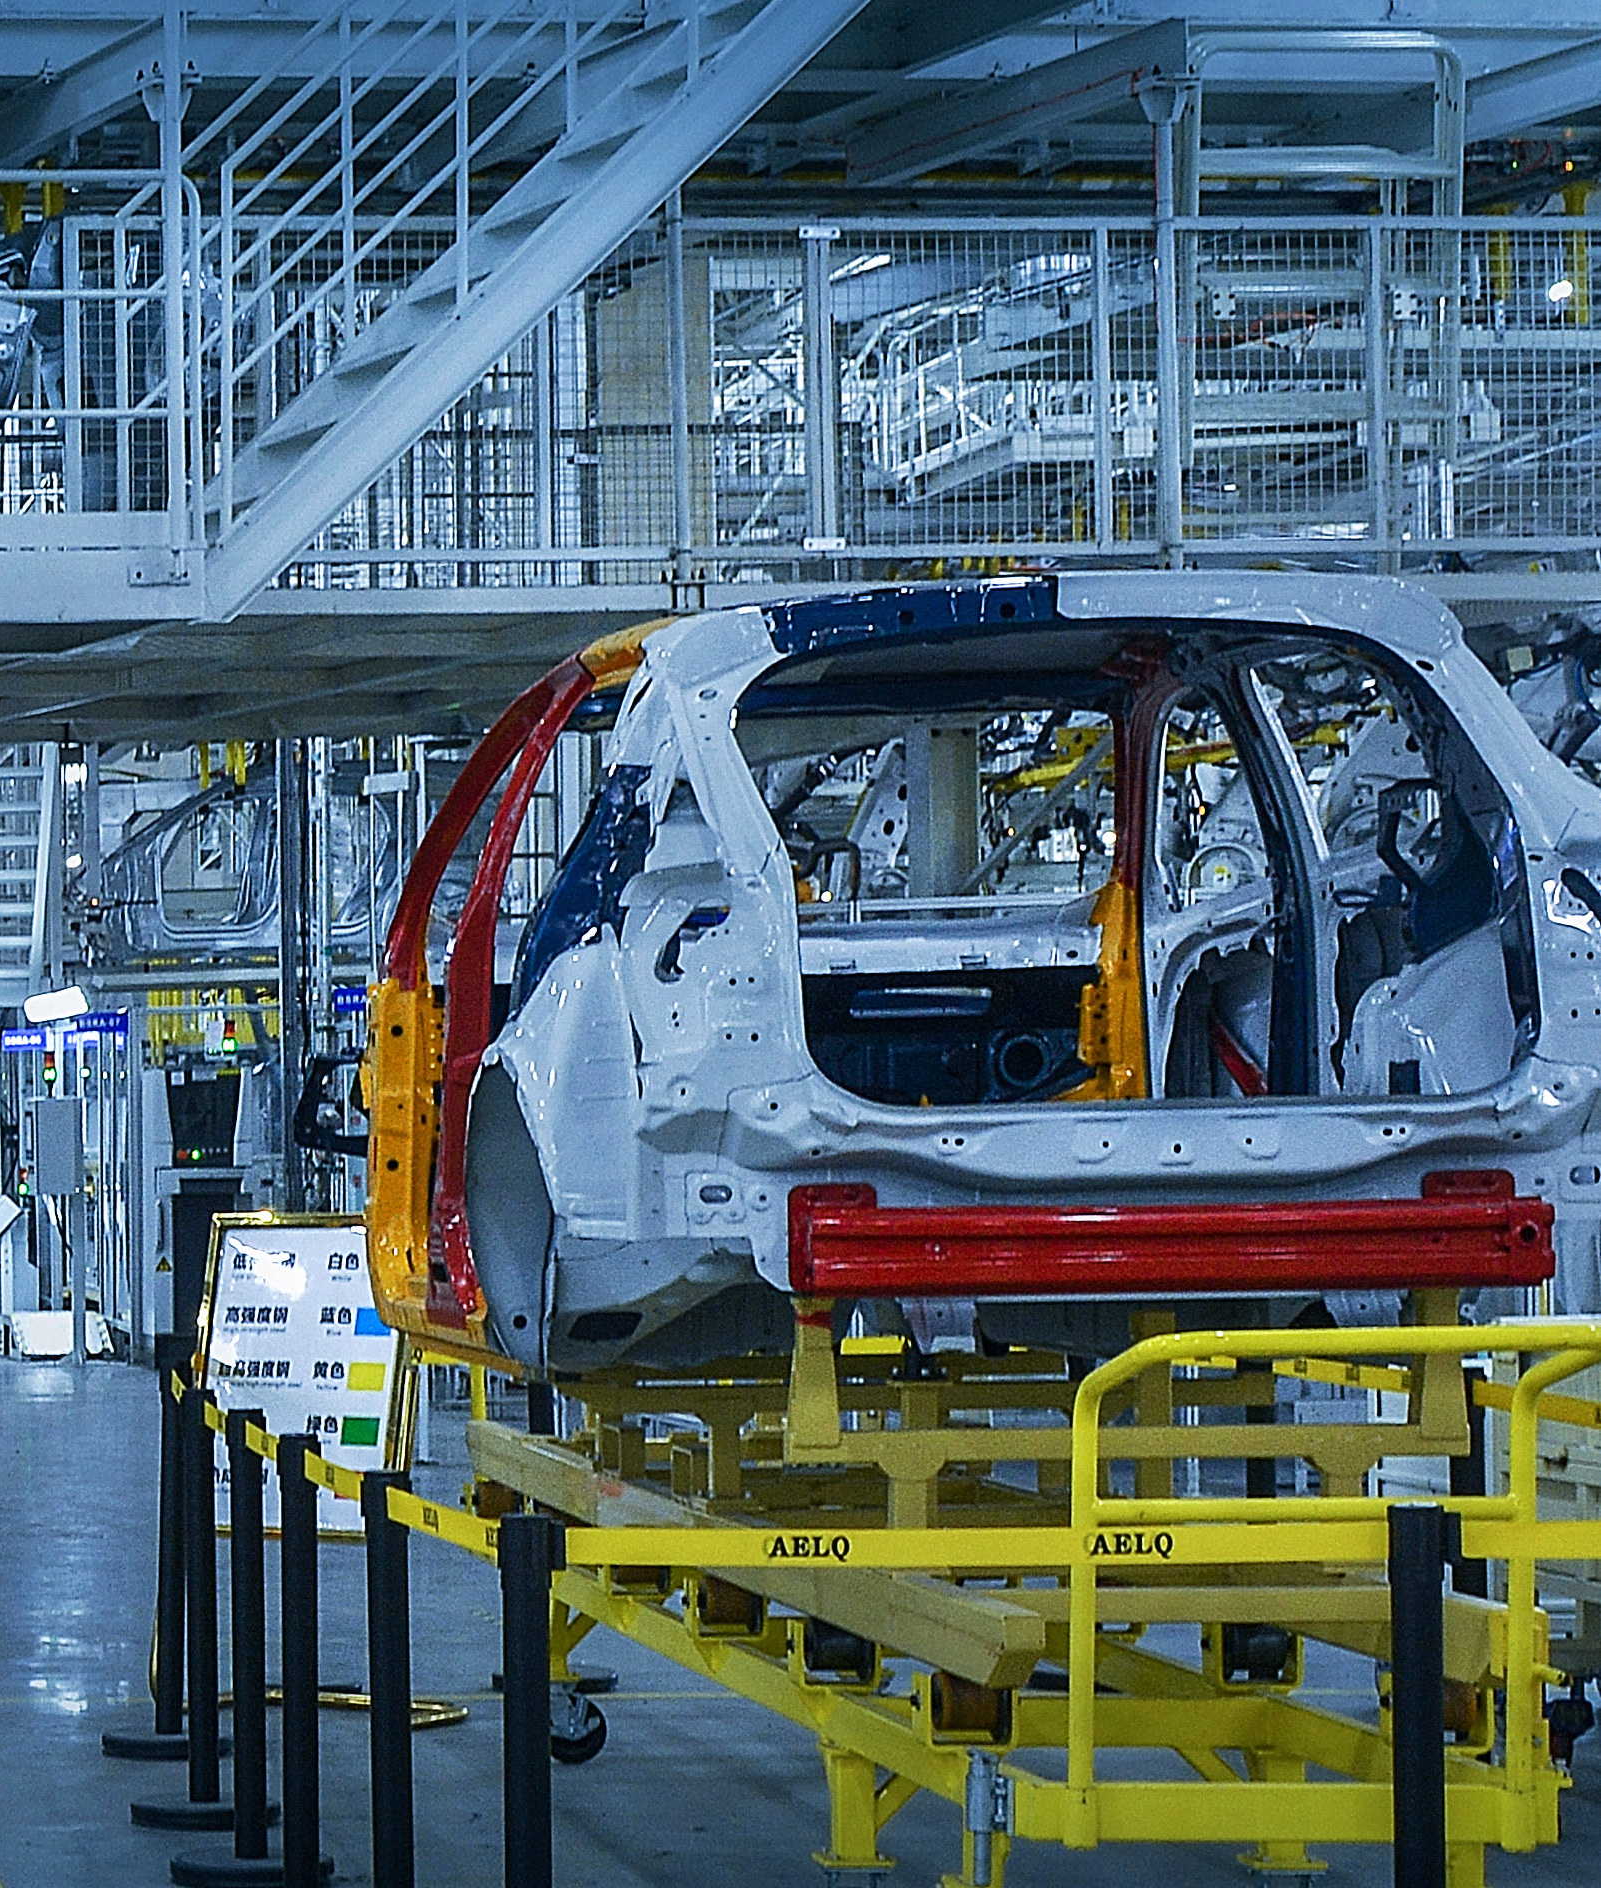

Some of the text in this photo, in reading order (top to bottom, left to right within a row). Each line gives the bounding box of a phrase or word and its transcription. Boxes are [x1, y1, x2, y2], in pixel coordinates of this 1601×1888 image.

[327, 1252, 360, 1271] 白色
[768, 1535, 850, 1562] AELQ
[1089, 1532, 1173, 1559] AELQ
